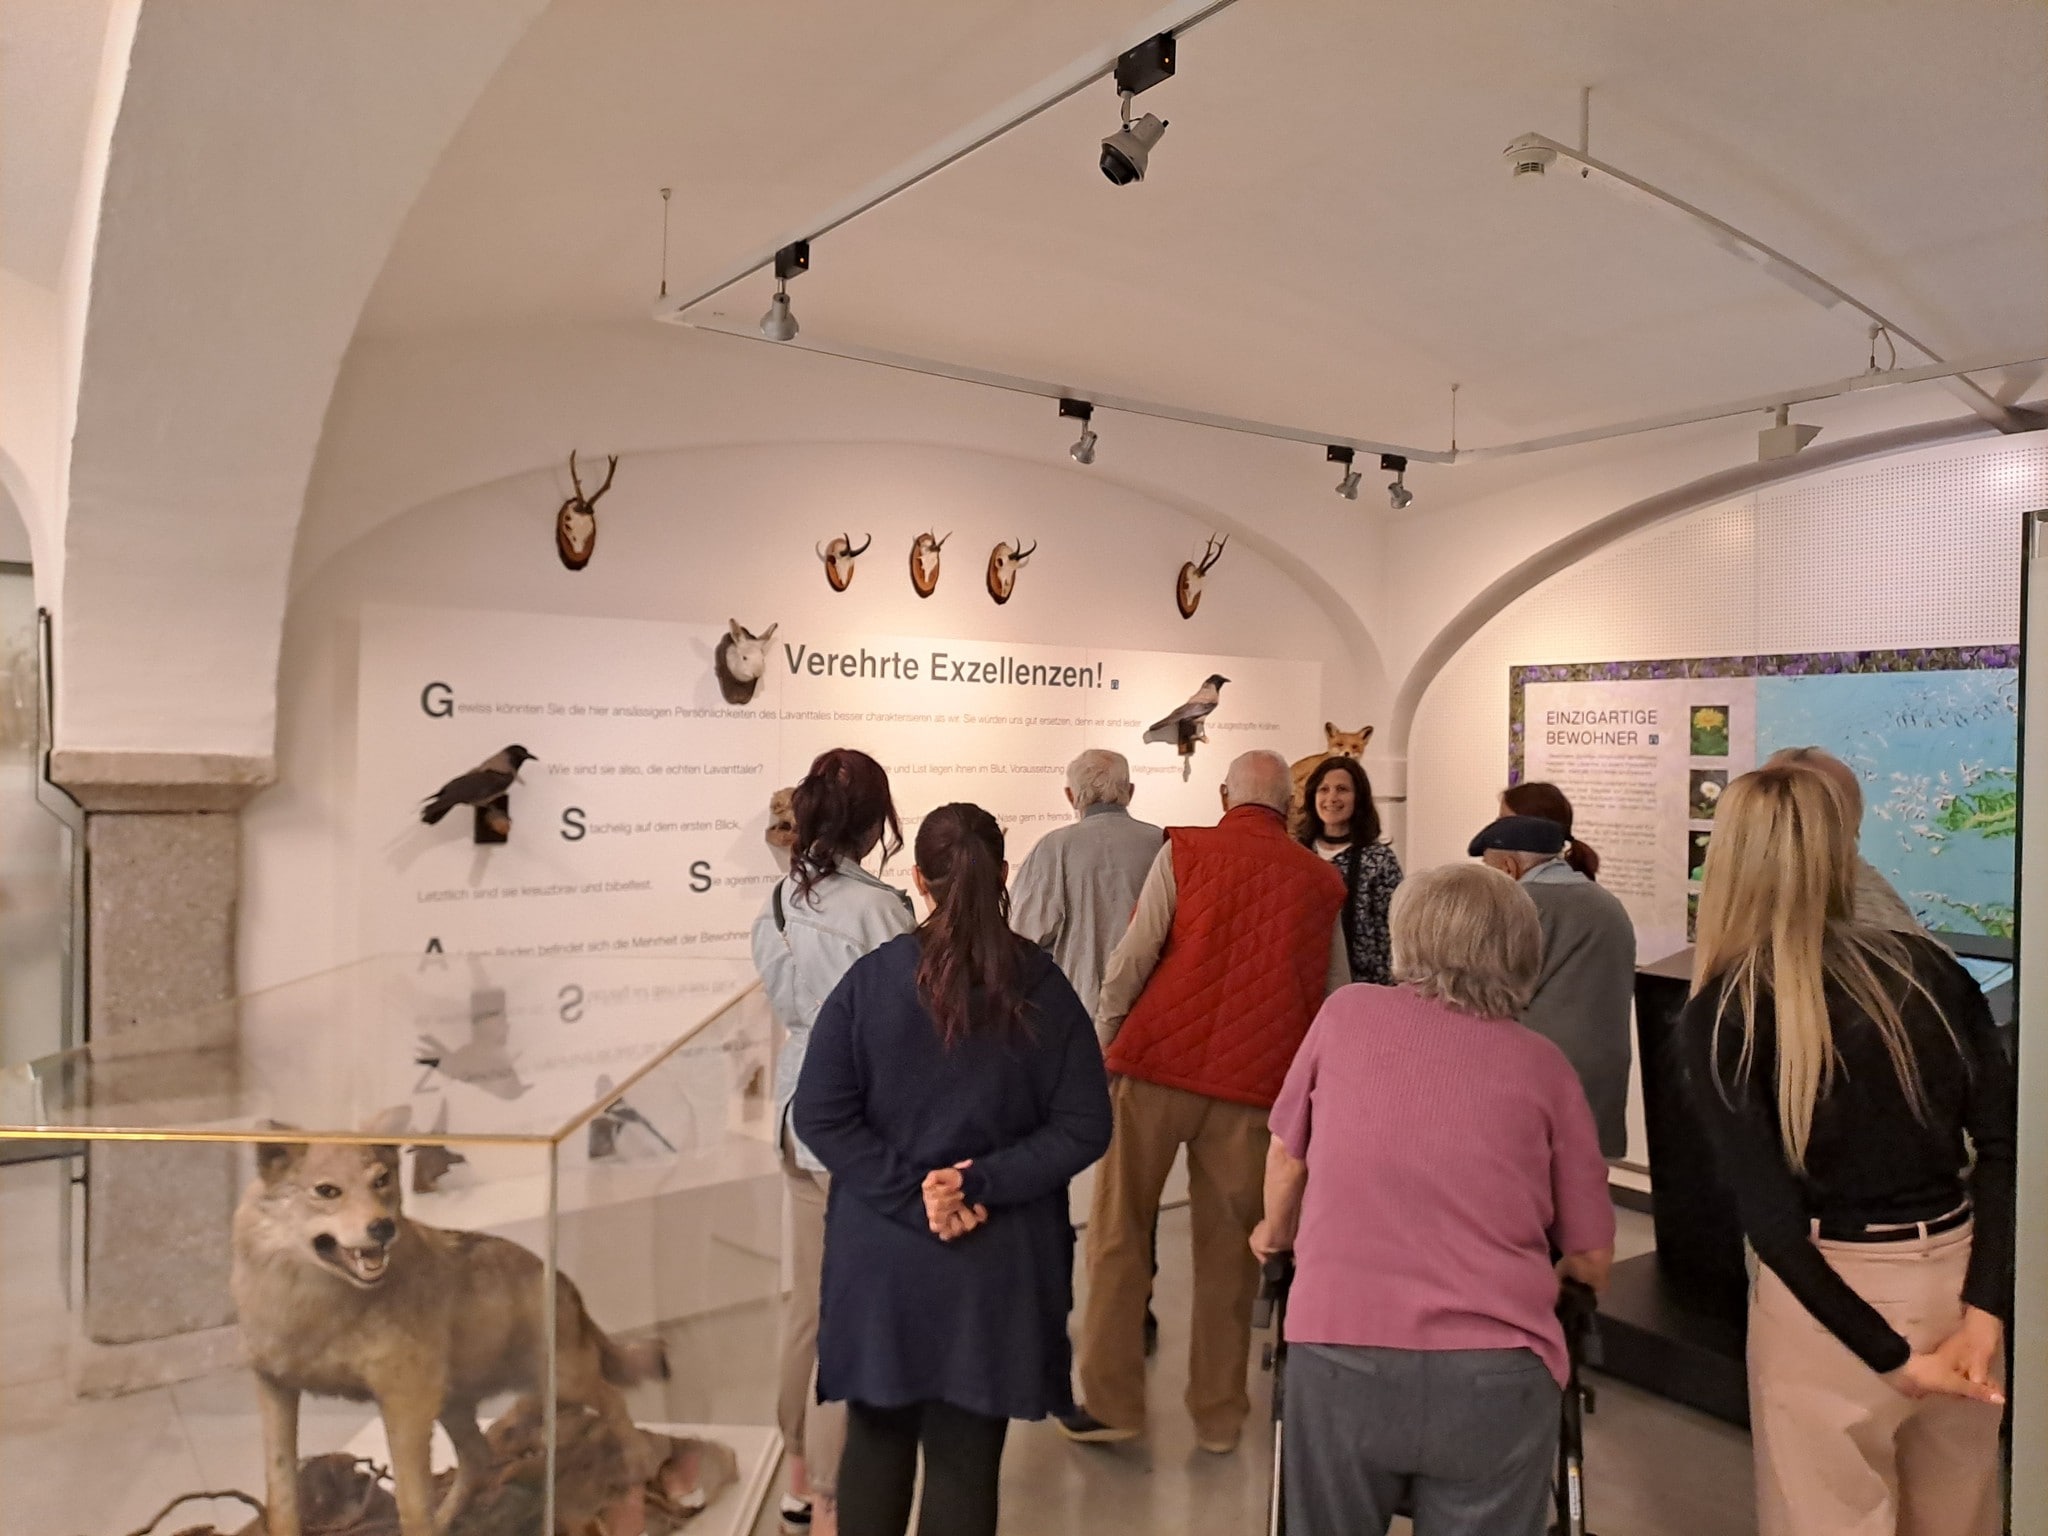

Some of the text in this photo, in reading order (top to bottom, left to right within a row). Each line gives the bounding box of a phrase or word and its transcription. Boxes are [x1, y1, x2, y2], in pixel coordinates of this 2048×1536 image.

[783, 643, 1103, 688] Verehrte Exzellenzen!
[496, 703, 544, 715] könnten
[548, 703, 565, 715] Sie
[569, 704, 585, 715] die
[589, 705, 608, 716] hier
[675, 707, 756, 720] Persönlichkeiten
[759, 709, 776, 720] des
[779, 709, 831, 721] Lavanttales
[834, 710, 862, 721] besser
[963, 713, 976, 724] Sie
[978, 714, 1007, 725] würden
[1009, 716, 1023, 725] uns
[1025, 716, 1037, 727] gut
[1074, 717, 1093, 726] denn
[1546, 709, 1658, 725] EINZIGARTIGE
[1546, 730, 1638, 745] BEWOHNER
[548, 764, 570, 776] Wie
[574, 764, 597, 775] sind
[600, 764, 615, 775] sie
[646, 764, 662, 775] die
[666, 764, 700, 775] echten
[704, 763, 763, 776] Lavanttaler?
[895, 764, 909, 774] und
[912, 763, 926, 774] List
[929, 763, 953, 775] liegen
[1009, 763, 1064, 776] Voraussetzung
[635, 822, 652, 834] auf
[656, 822, 677, 833] dem
[680, 820, 711, 832] ersten
[681, 934, 697, 945] der
